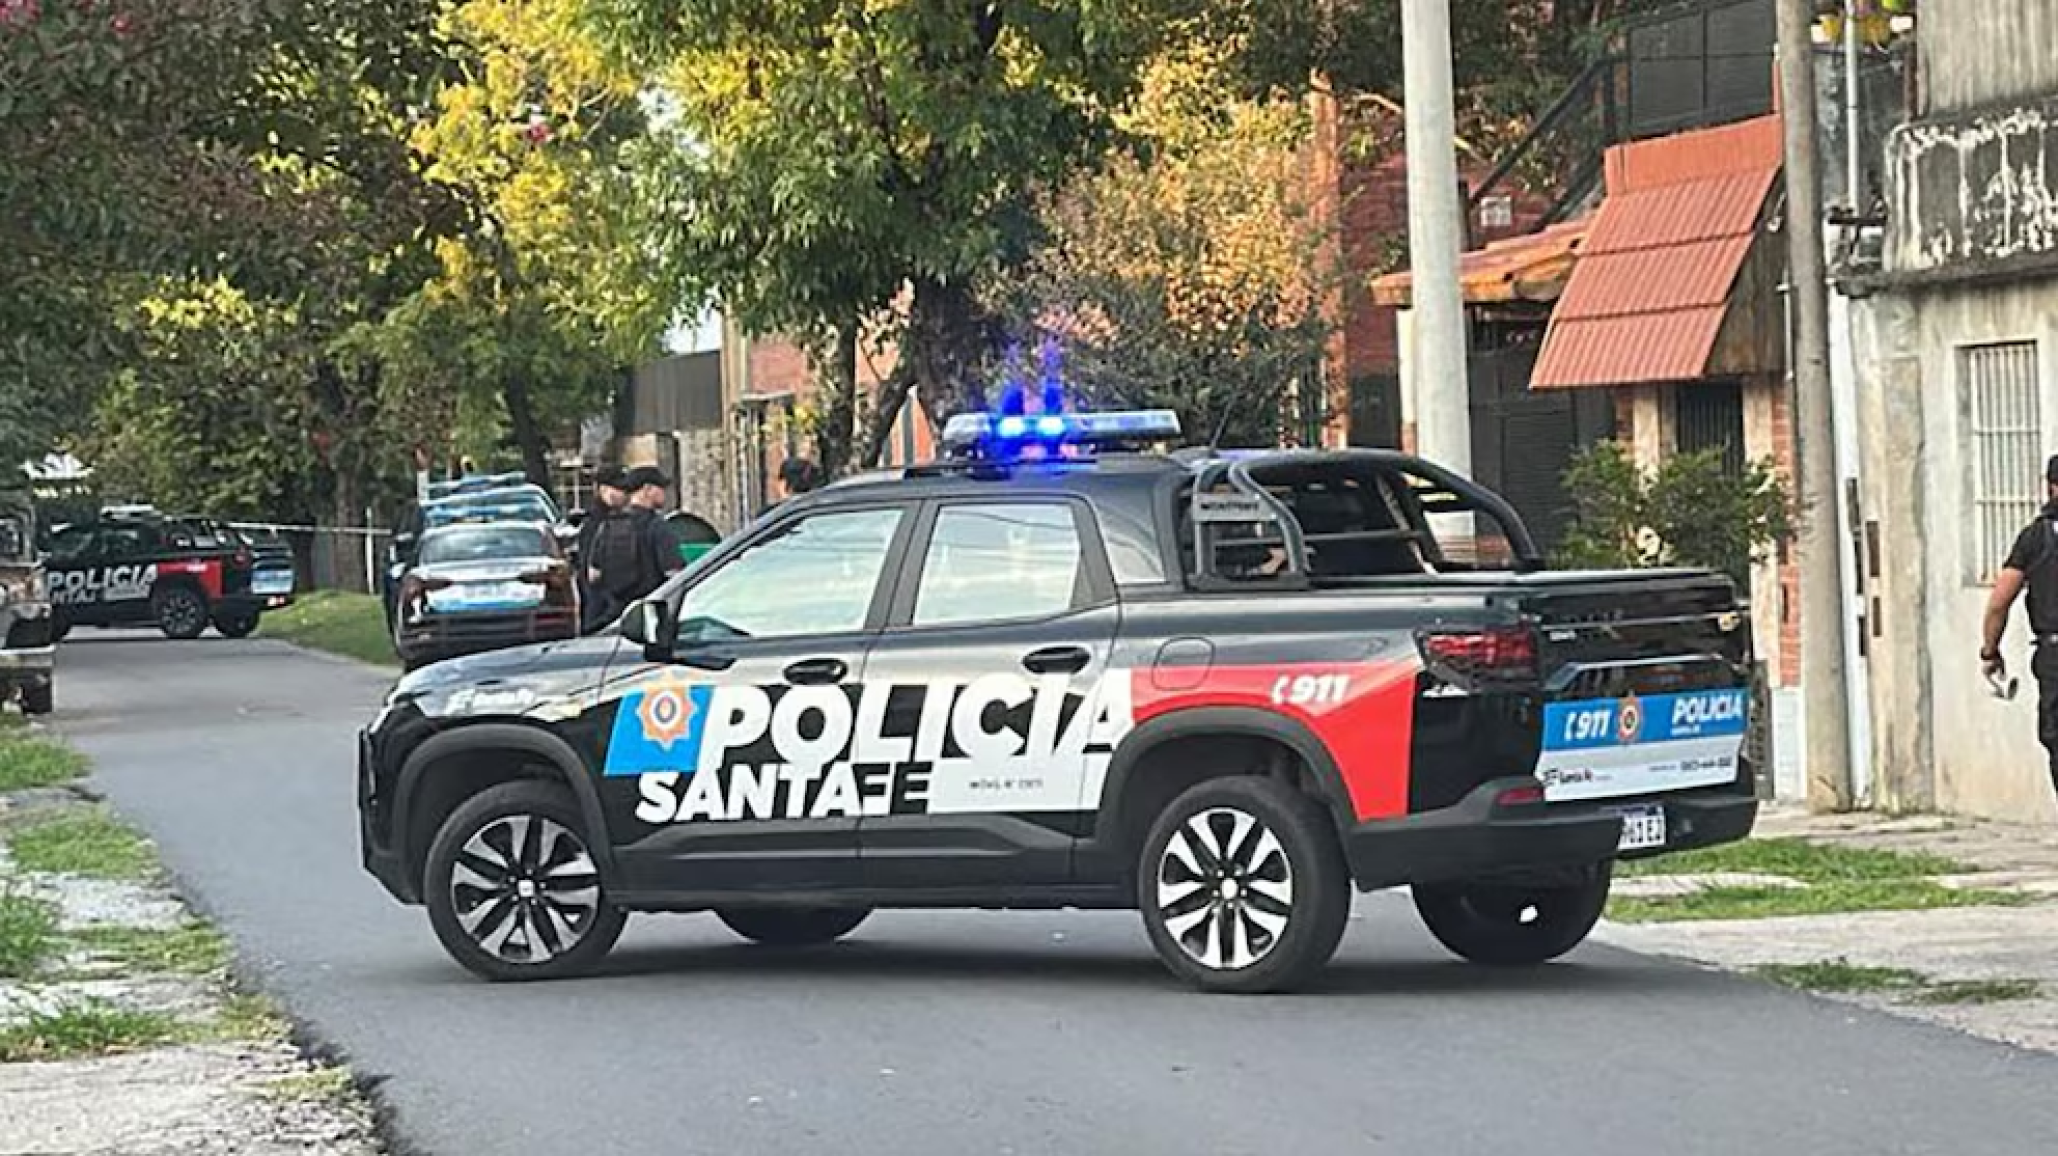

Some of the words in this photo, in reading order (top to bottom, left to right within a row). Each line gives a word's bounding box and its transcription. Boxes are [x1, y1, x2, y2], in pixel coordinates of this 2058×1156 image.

[47, 563, 157, 592] POLICIA
[1289, 674, 1349, 704] 911
[693, 666, 1134, 774] POLICIA
[1671, 694, 1743, 725] POLICIA
[1576, 710, 1611, 740] 911
[634, 762, 863, 824] SANTA
